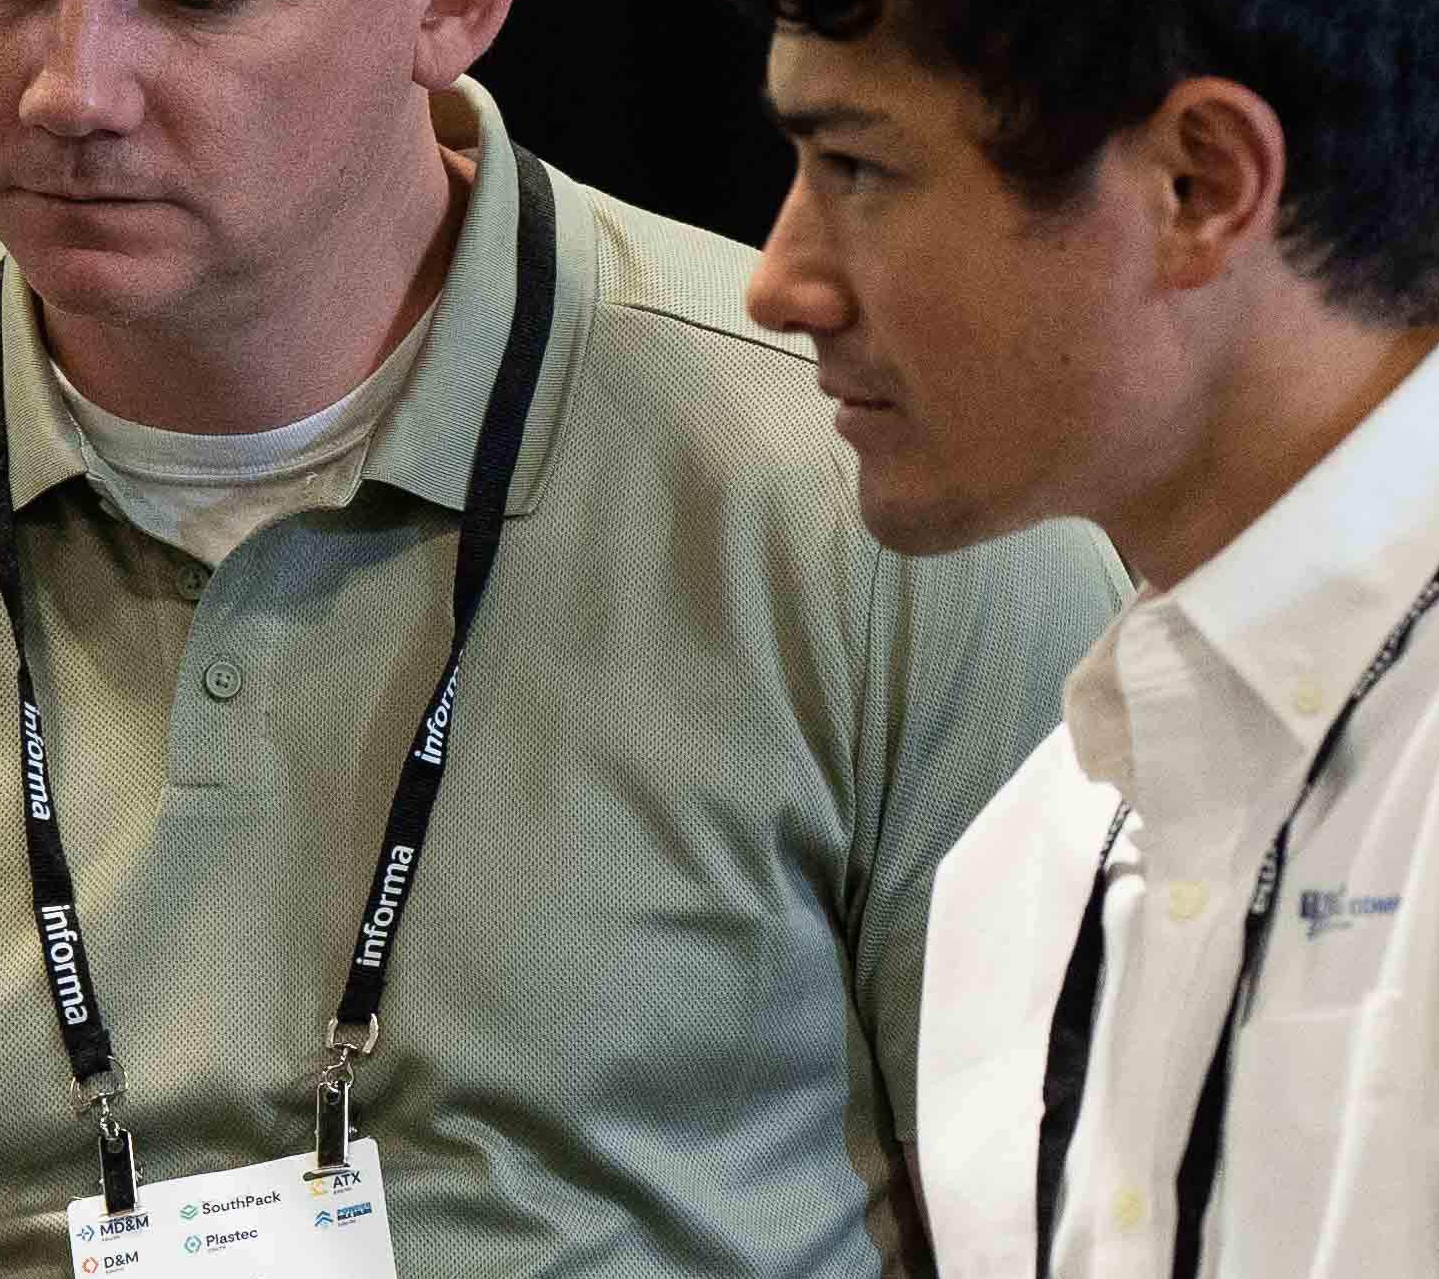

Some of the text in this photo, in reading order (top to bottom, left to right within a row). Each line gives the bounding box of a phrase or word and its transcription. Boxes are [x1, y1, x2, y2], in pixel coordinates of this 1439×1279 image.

[23, 701, 51, 821] informa
[356, 844, 415, 968] informa
[40, 904, 89, 1025] informa
[332, 1170, 362, 1189] ATX
[201, 1190, 282, 1215] SouthPack
[99, 1215, 150, 1237] MD&M
[205, 1228, 259, 1248] Plastec
[103, 1250, 139, 1269] D&M
